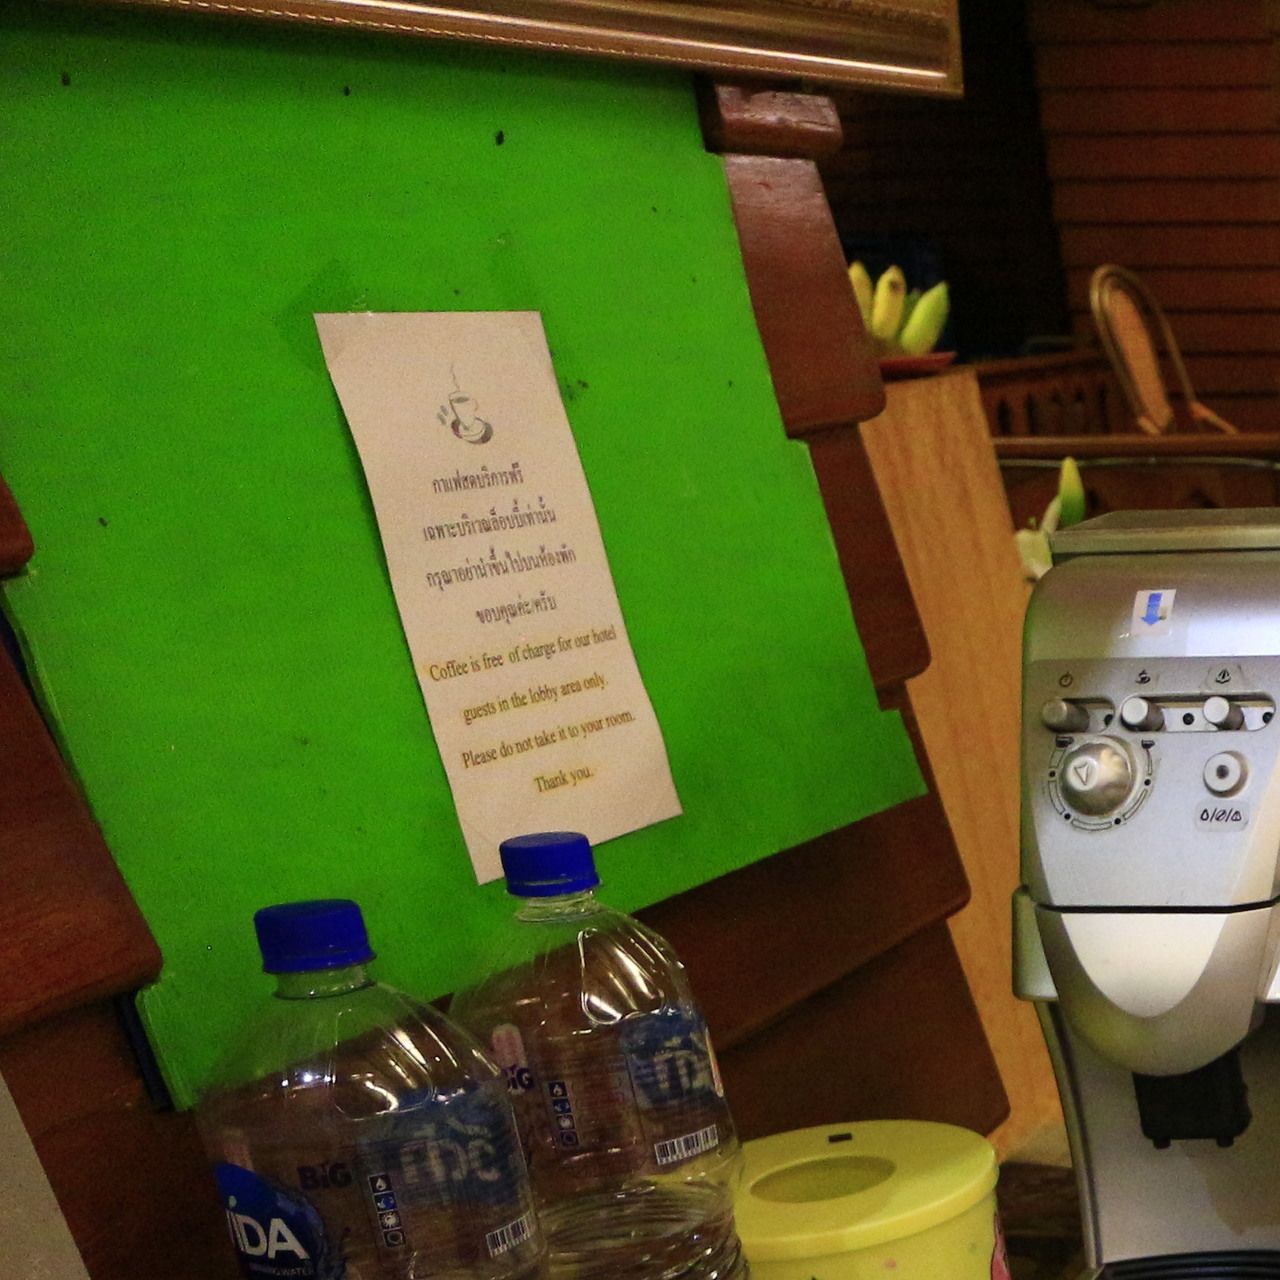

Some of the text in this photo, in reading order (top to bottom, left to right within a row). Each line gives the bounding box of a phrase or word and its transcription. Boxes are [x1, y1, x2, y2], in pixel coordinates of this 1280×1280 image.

[429, 625, 617, 682] Coffee is free of charge for our hotel
[463, 672, 609, 725] guests in the lobby area only.
[462, 710, 636, 769] Please do not take it to your room.
[534, 766, 595, 793] Thank you.
